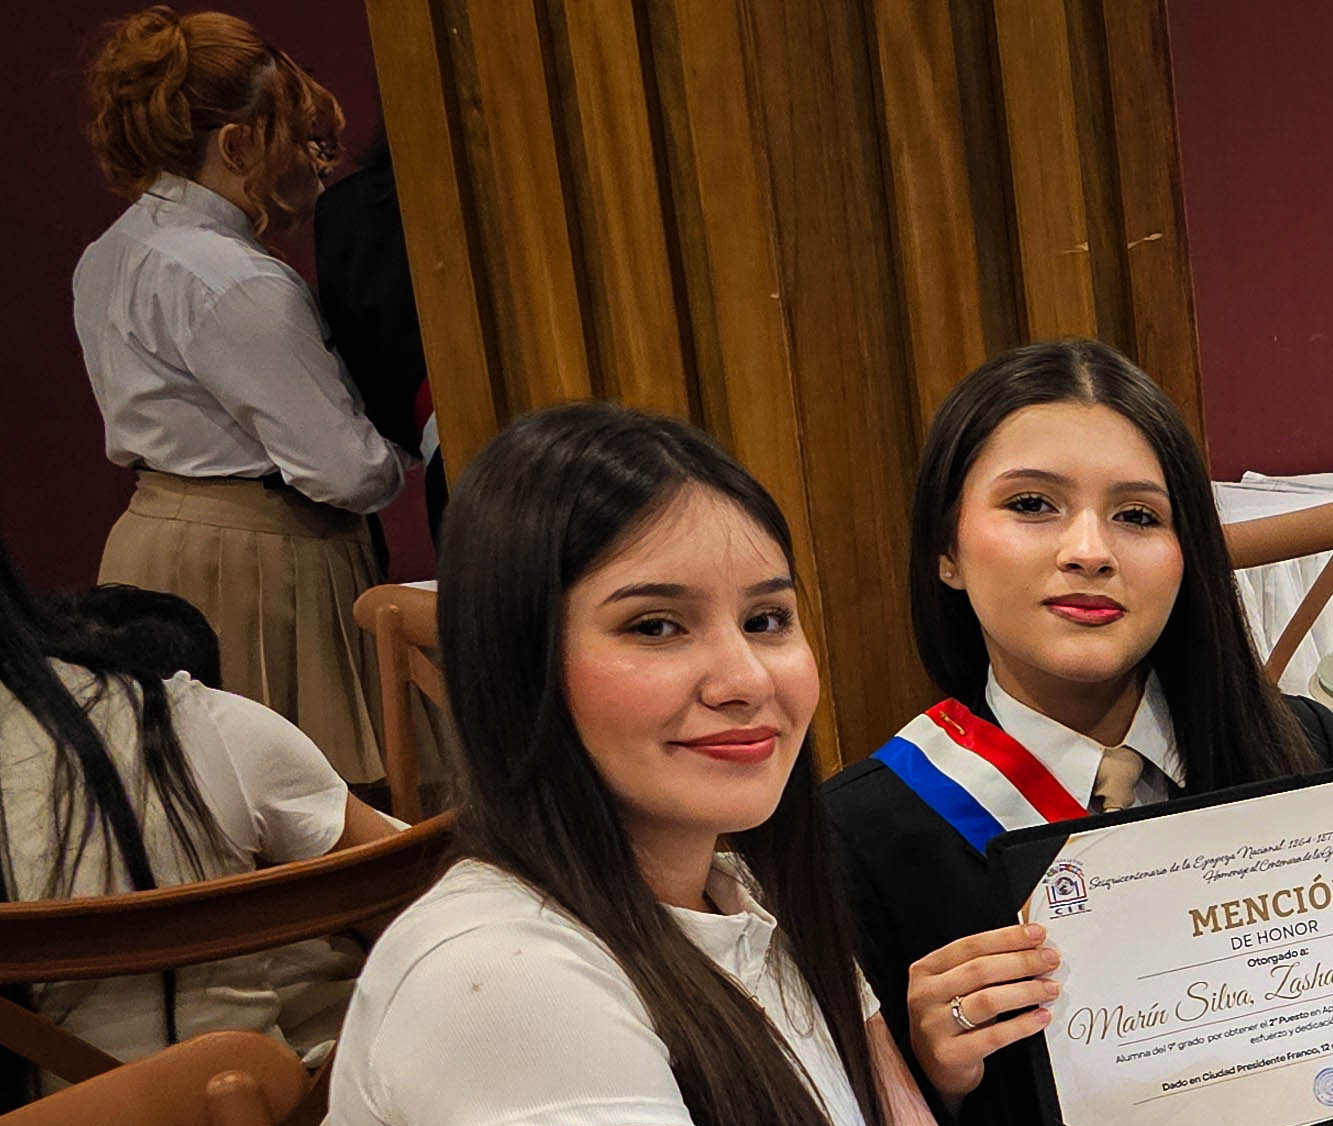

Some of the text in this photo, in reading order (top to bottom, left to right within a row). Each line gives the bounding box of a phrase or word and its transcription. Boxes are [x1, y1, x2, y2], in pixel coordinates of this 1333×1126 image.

[1054, 903, 1086, 915] CIE
[1230, 919, 1320, 951] DE HONOR
[1247, 947, 1310, 968] Otorgado a:
[1067, 1002, 1170, 1046] Marín
[1175, 981, 1255, 1022] Silva,
[1116, 1050, 1151, 1064] Alumna
[1151, 1044, 1167, 1057] del
[1178, 1037, 1205, 1051] grado
[1207, 1032, 1223, 1043] por
[1224, 1022, 1259, 1038] obtener
[1259, 1020, 1268, 1029] el
[1278, 1011, 1310, 1025] Puesto
[1310, 1007, 1322, 1017] en
[1250, 1029, 1288, 1044] esfuerzo
[1288, 1028, 1295, 1037] y
[1162, 1080, 1188, 1092] Dado
[1189, 1076, 1201, 1085] en
[1201, 1066, 1236, 1082] Ciudad
[1236, 1053, 1286, 1073] Presidente
[1286, 1046, 1320, 1061] Franco,
[1320, 1042, 1330, 1052] 12
